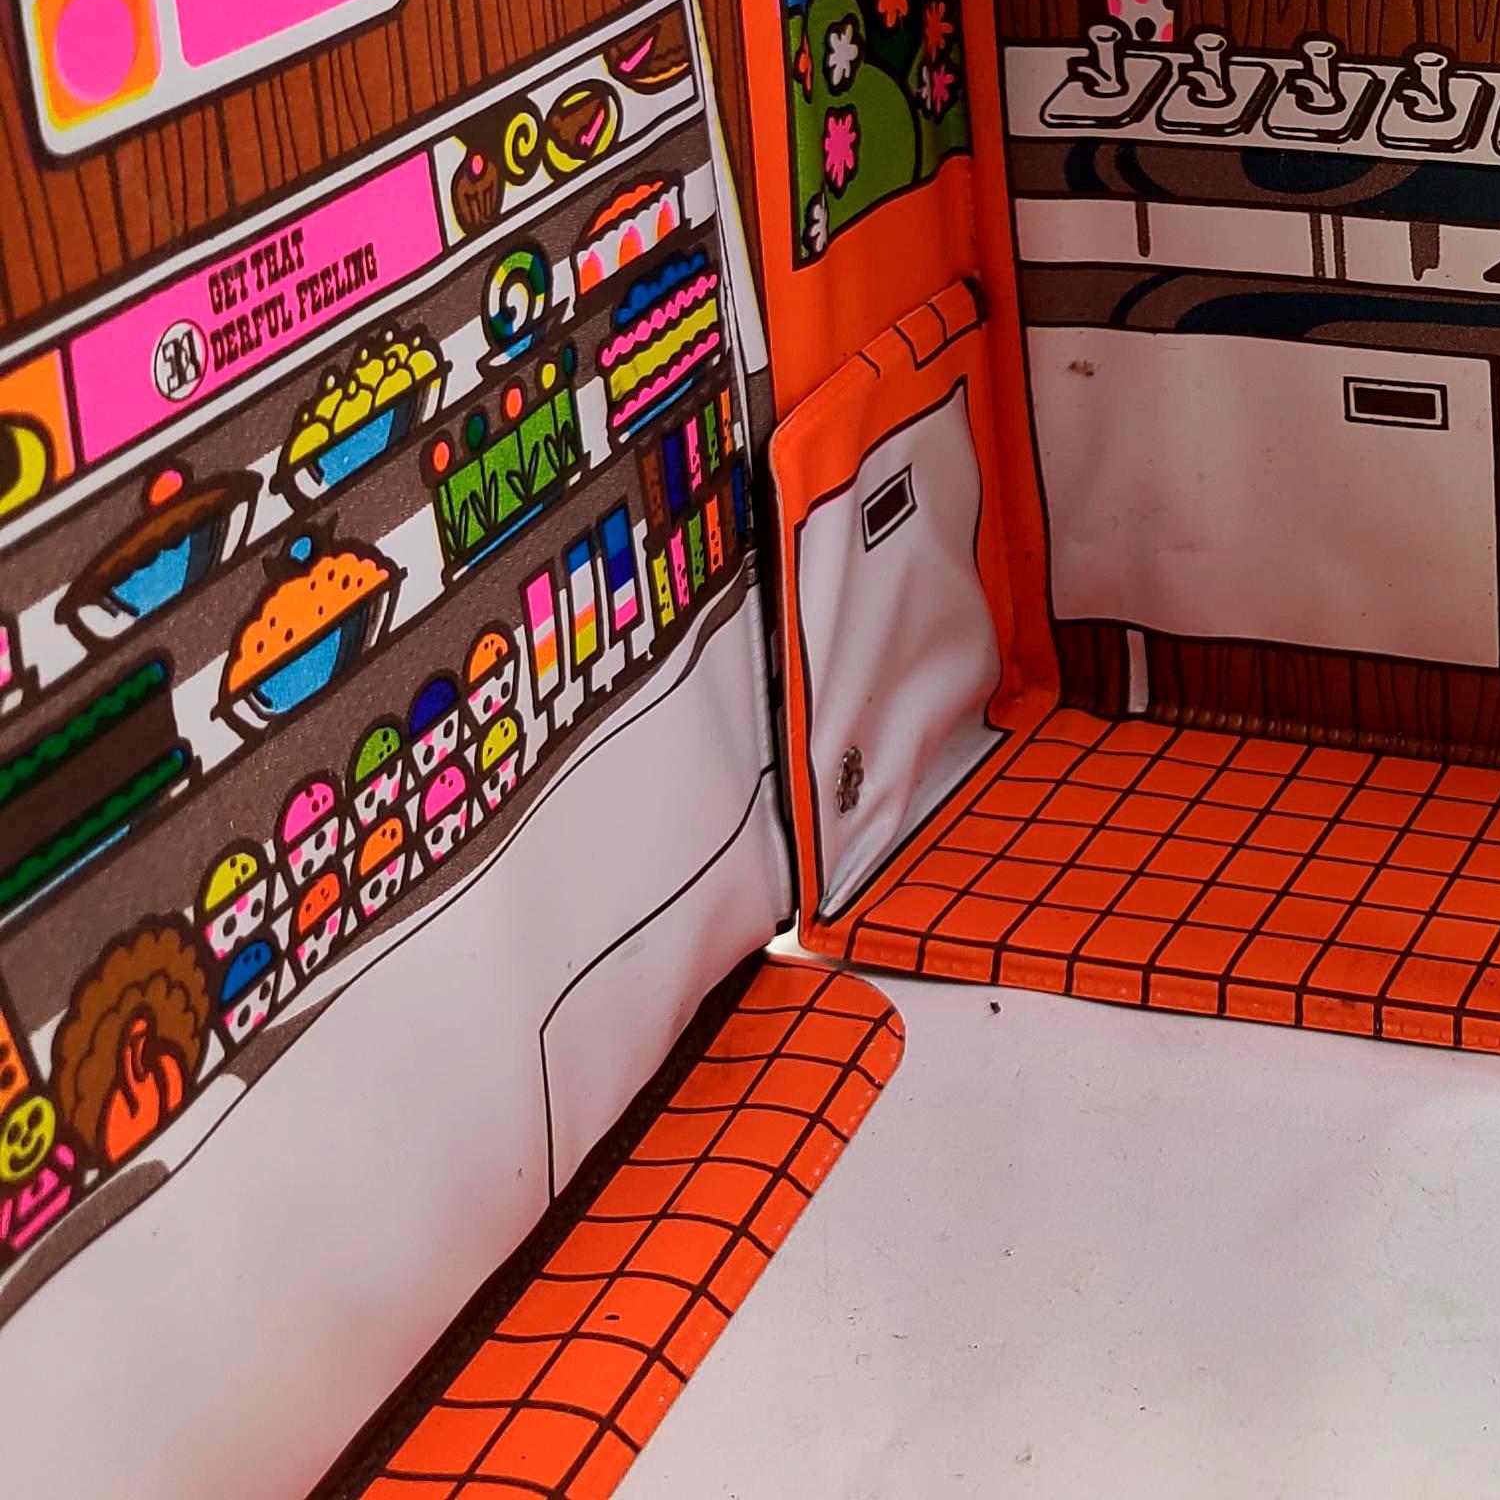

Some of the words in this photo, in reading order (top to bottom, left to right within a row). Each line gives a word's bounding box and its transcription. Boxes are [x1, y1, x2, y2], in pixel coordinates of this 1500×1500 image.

[208, 258, 248, 315] GET
[251, 227, 305, 291] THAT
[296, 242, 378, 323] FEELING
